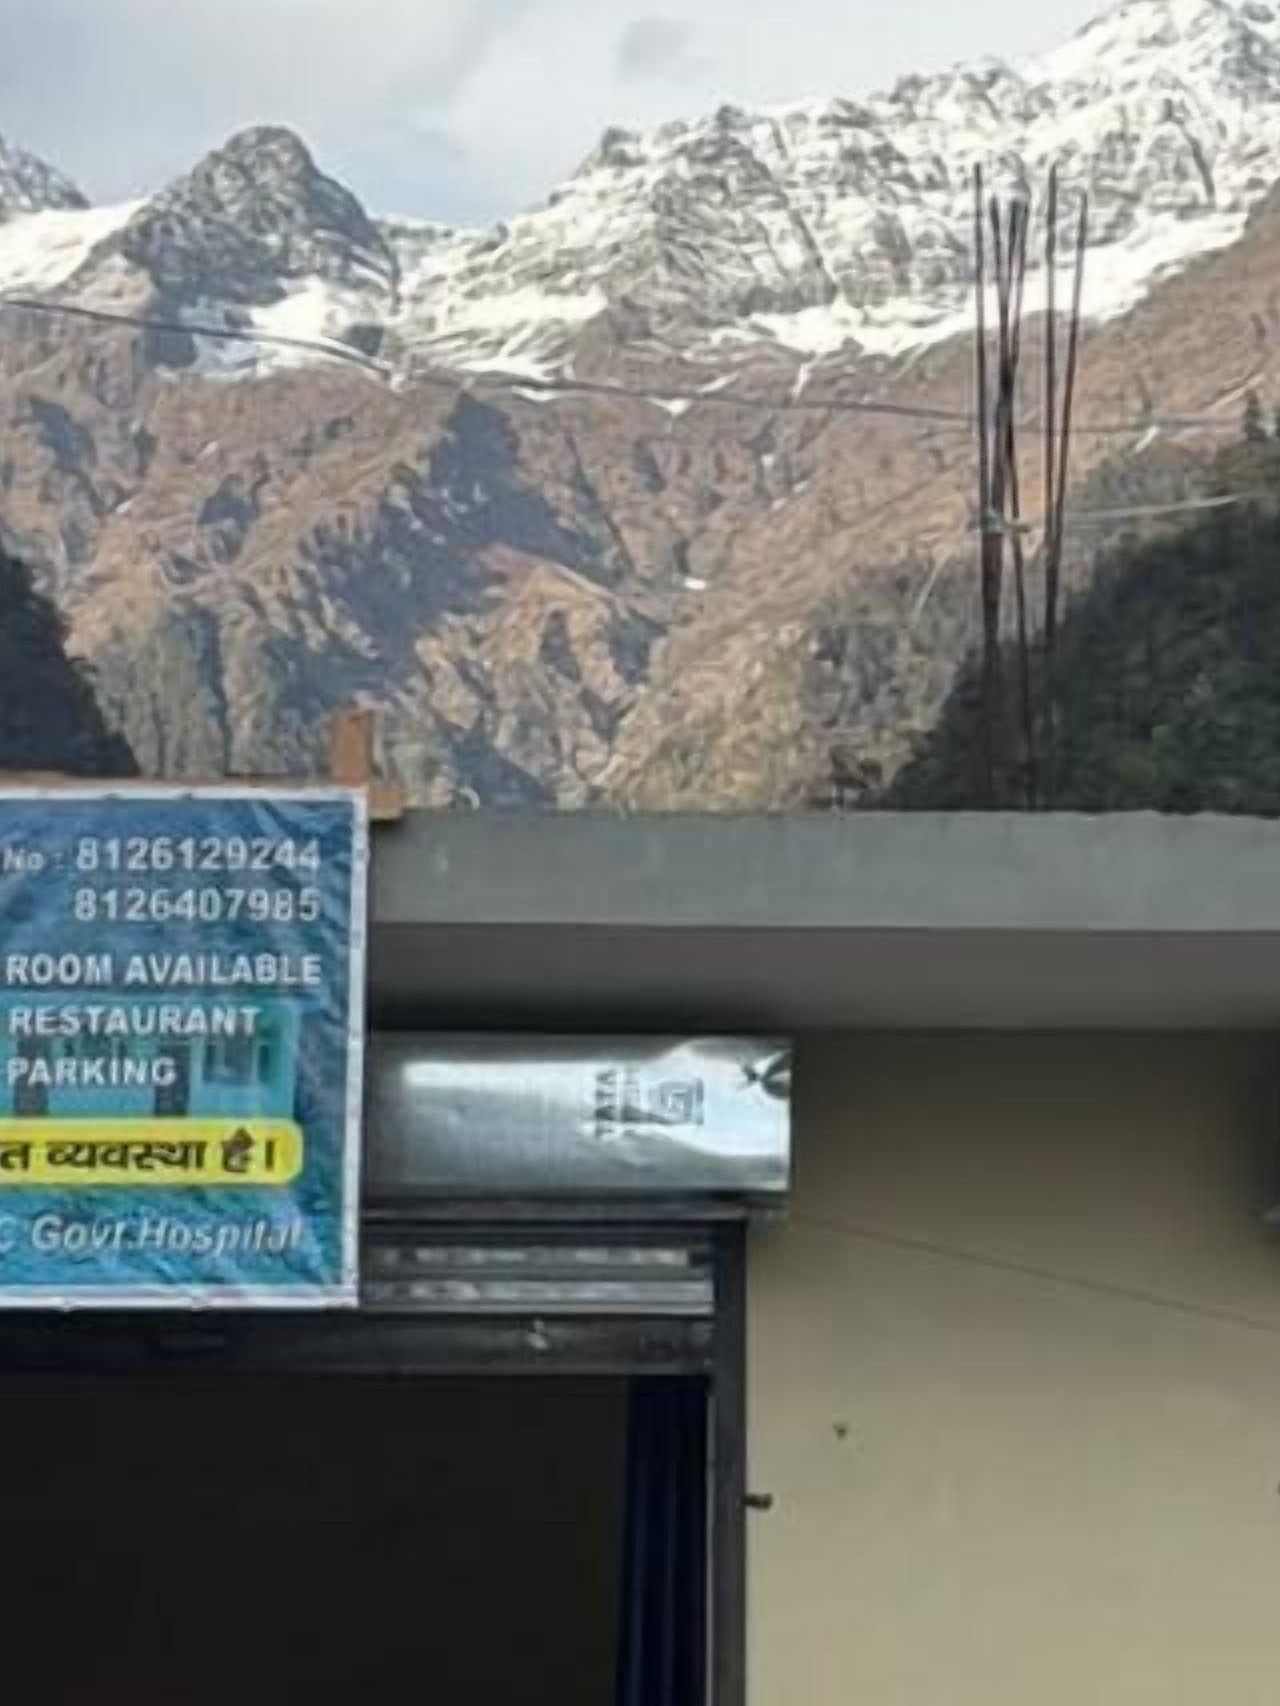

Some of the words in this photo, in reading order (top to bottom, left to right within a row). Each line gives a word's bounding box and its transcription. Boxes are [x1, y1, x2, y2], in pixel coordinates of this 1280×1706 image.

[75, 836, 321, 871] 8126129244
[73, 887, 321, 923] 8126407985
[6, 953, 113, 986] ROOM
[124, 952, 322, 986] AVAILABLE
[8, 1005, 261, 1037] RESTAURANT
[7, 1056, 178, 1087] PARKING
[45, 1140, 208, 1171] व्यवस्था
